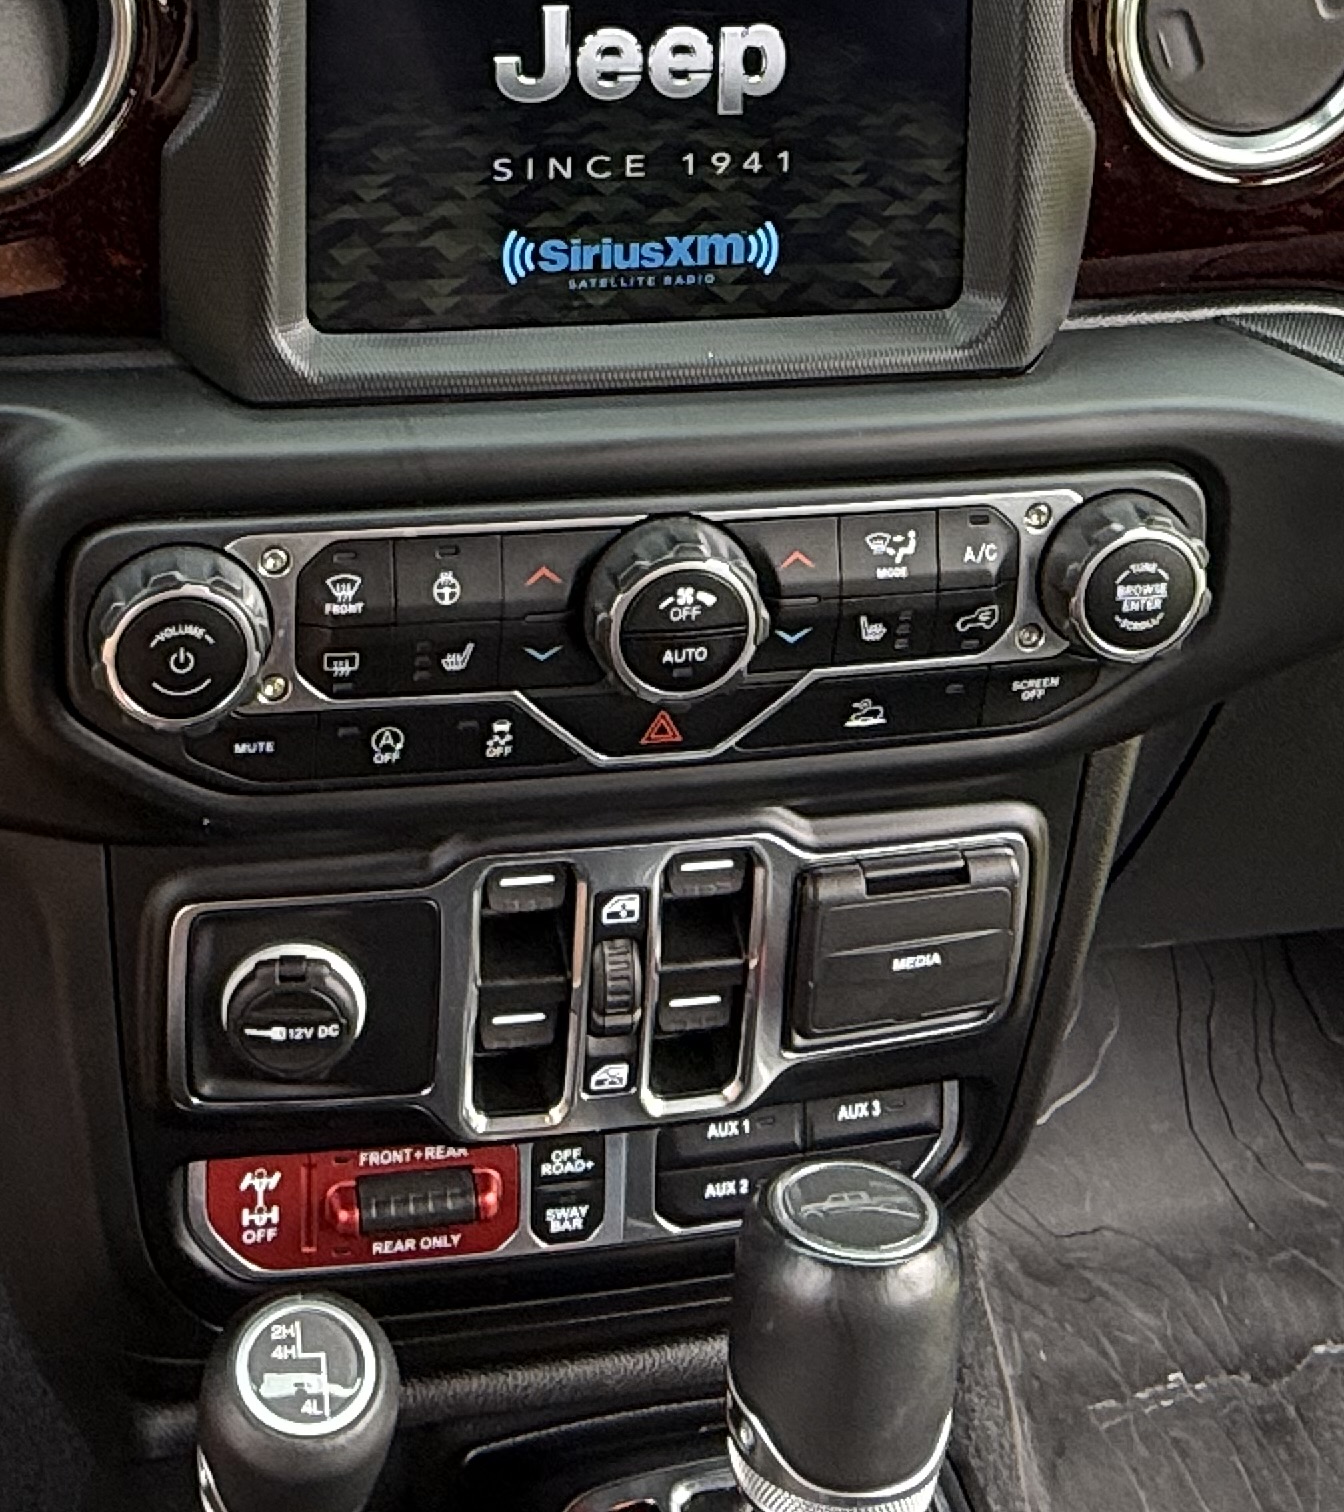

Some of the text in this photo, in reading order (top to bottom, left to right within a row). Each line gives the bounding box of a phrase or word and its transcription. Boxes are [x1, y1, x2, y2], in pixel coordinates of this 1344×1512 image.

[493, 3, 787, 116] Jeep
[492, 150, 792, 182] SINCE 1941
[568, 272, 716, 290] SATELLITE RADIO
[963, 542, 998, 564] A/C
[324, 600, 365, 616] FRONT
[670, 605, 699, 622] OFF
[156, 624, 206, 641] VOLUME
[662, 646, 708, 665] AUTO
[1011, 676, 1060, 692] SCREEN
[1021, 688, 1046, 702] OFF
[233, 740, 275, 755] MUTE
[486, 745, 513, 758] OFF
[373, 749, 400, 765] OFF
[892, 951, 943, 972] MEDIA
[287, 1023, 340, 1041] 12V DC
[837, 1099, 882, 1122] AUX 3
[706, 1119, 751, 1139] AUX 1
[550, 1148, 582, 1165] OFF
[540, 1158, 595, 1178] ROAD+
[704, 1179, 749, 1199] AUX 2
[545, 1205, 589, 1224] SWAY
[550, 1217, 584, 1234] BAR
[242, 1227, 278, 1245] OFF
[372, 1234, 462, 1256] REAR ONLY
[270, 1324, 296, 1340] 2H
[270, 1344, 296, 1360] 4H
[300, 1399, 324, 1416] 4L
